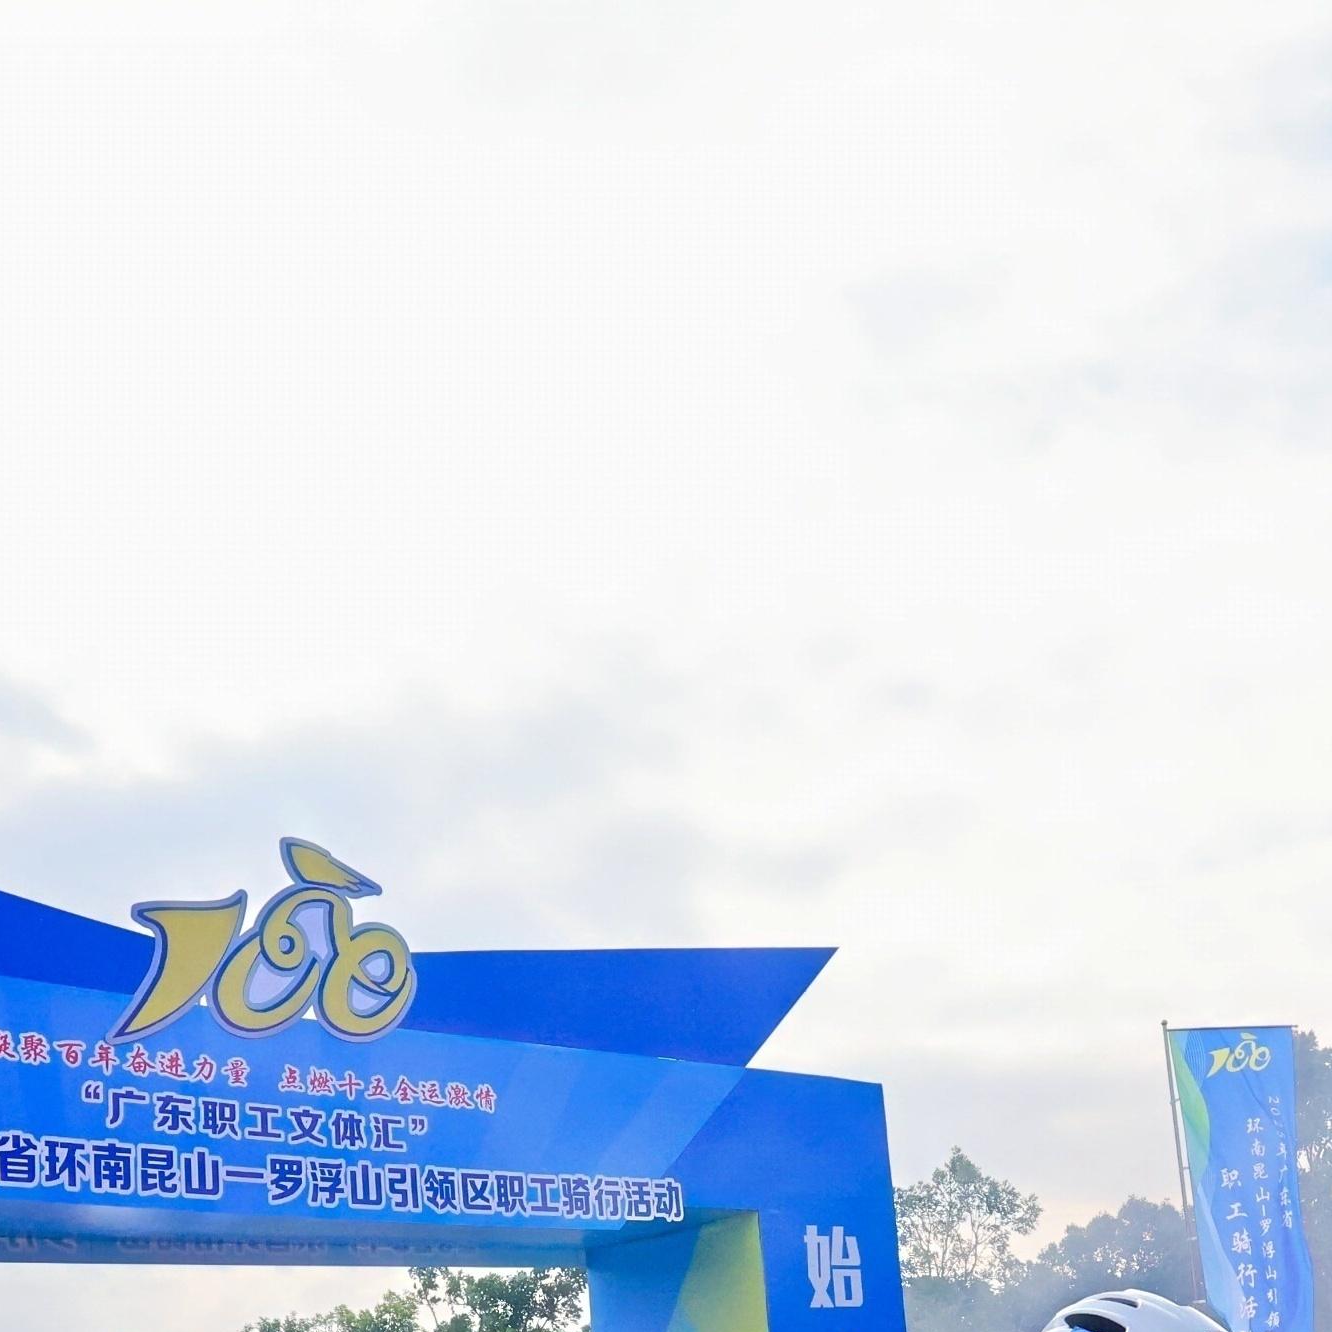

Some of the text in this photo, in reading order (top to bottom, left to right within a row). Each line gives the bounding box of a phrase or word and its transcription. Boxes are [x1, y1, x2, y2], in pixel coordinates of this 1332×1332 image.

[280, 1066, 497, 1112] 点燃十五全运激情
